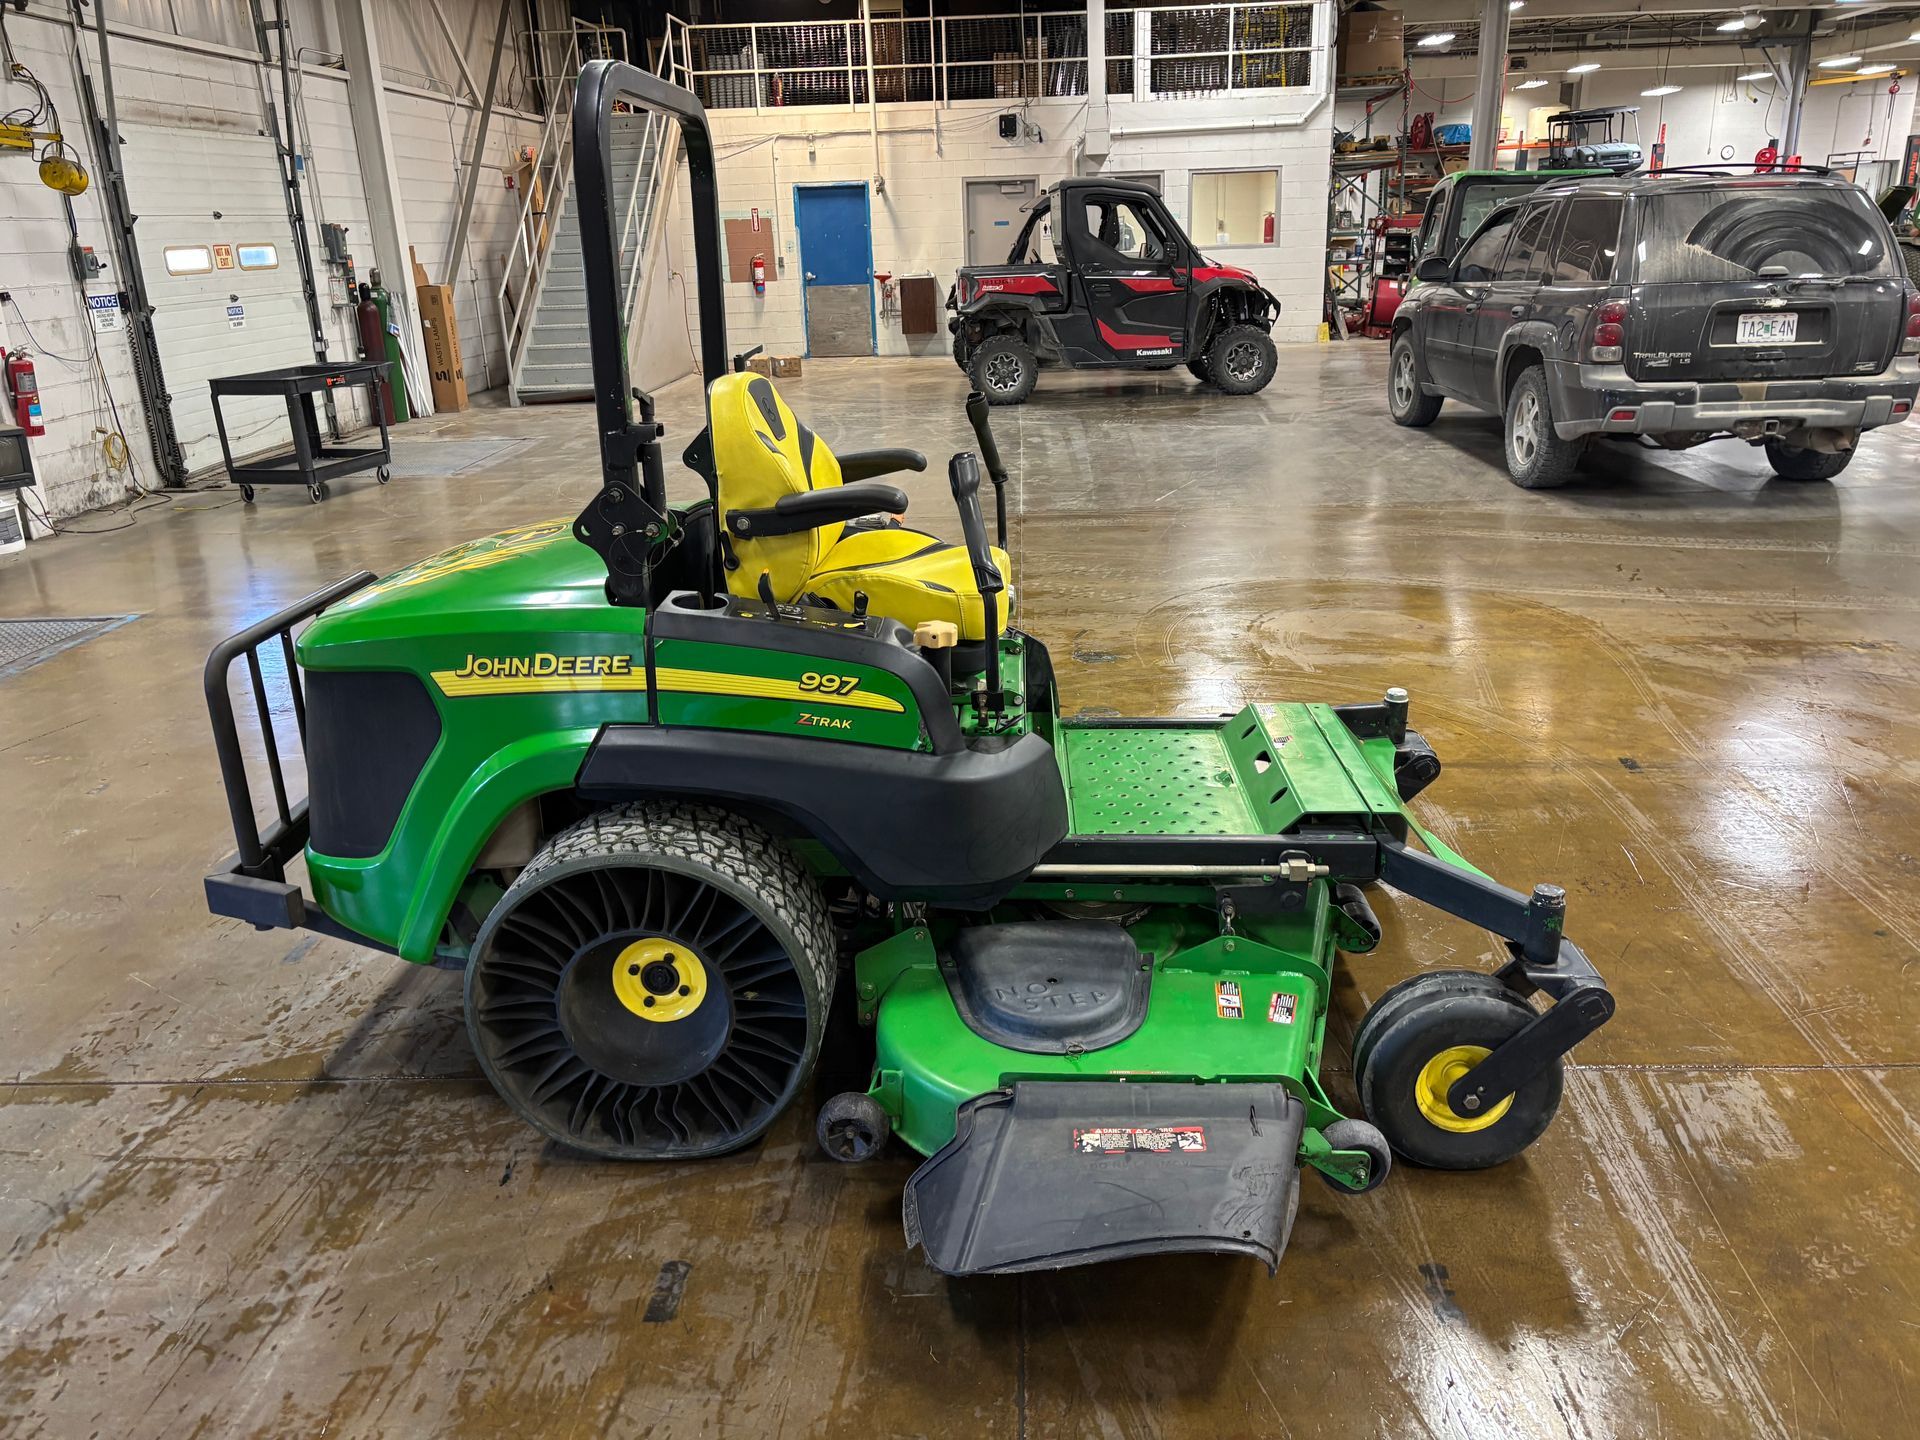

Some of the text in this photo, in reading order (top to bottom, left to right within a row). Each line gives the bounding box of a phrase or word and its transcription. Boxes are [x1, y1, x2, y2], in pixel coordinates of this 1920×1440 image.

[215, 247, 231, 257] NOT AN
[220, 257, 230, 267] EXIT
[88, 295, 118, 308] NOTICE
[227, 306, 243, 316] NOTICE
[1741, 319, 1795, 338] TA2 E4N
[431, 317, 444, 366] WASTE LAMPS
[1136, 347, 1173, 357] Kawasaki
[455, 652, 632, 677] JOHN DEERE
[798, 671, 861, 697] 997
[797, 713, 853, 730] ZTRAK
[994, 983, 1049, 1001] NO
[1024, 991, 1106, 1013] STEP
